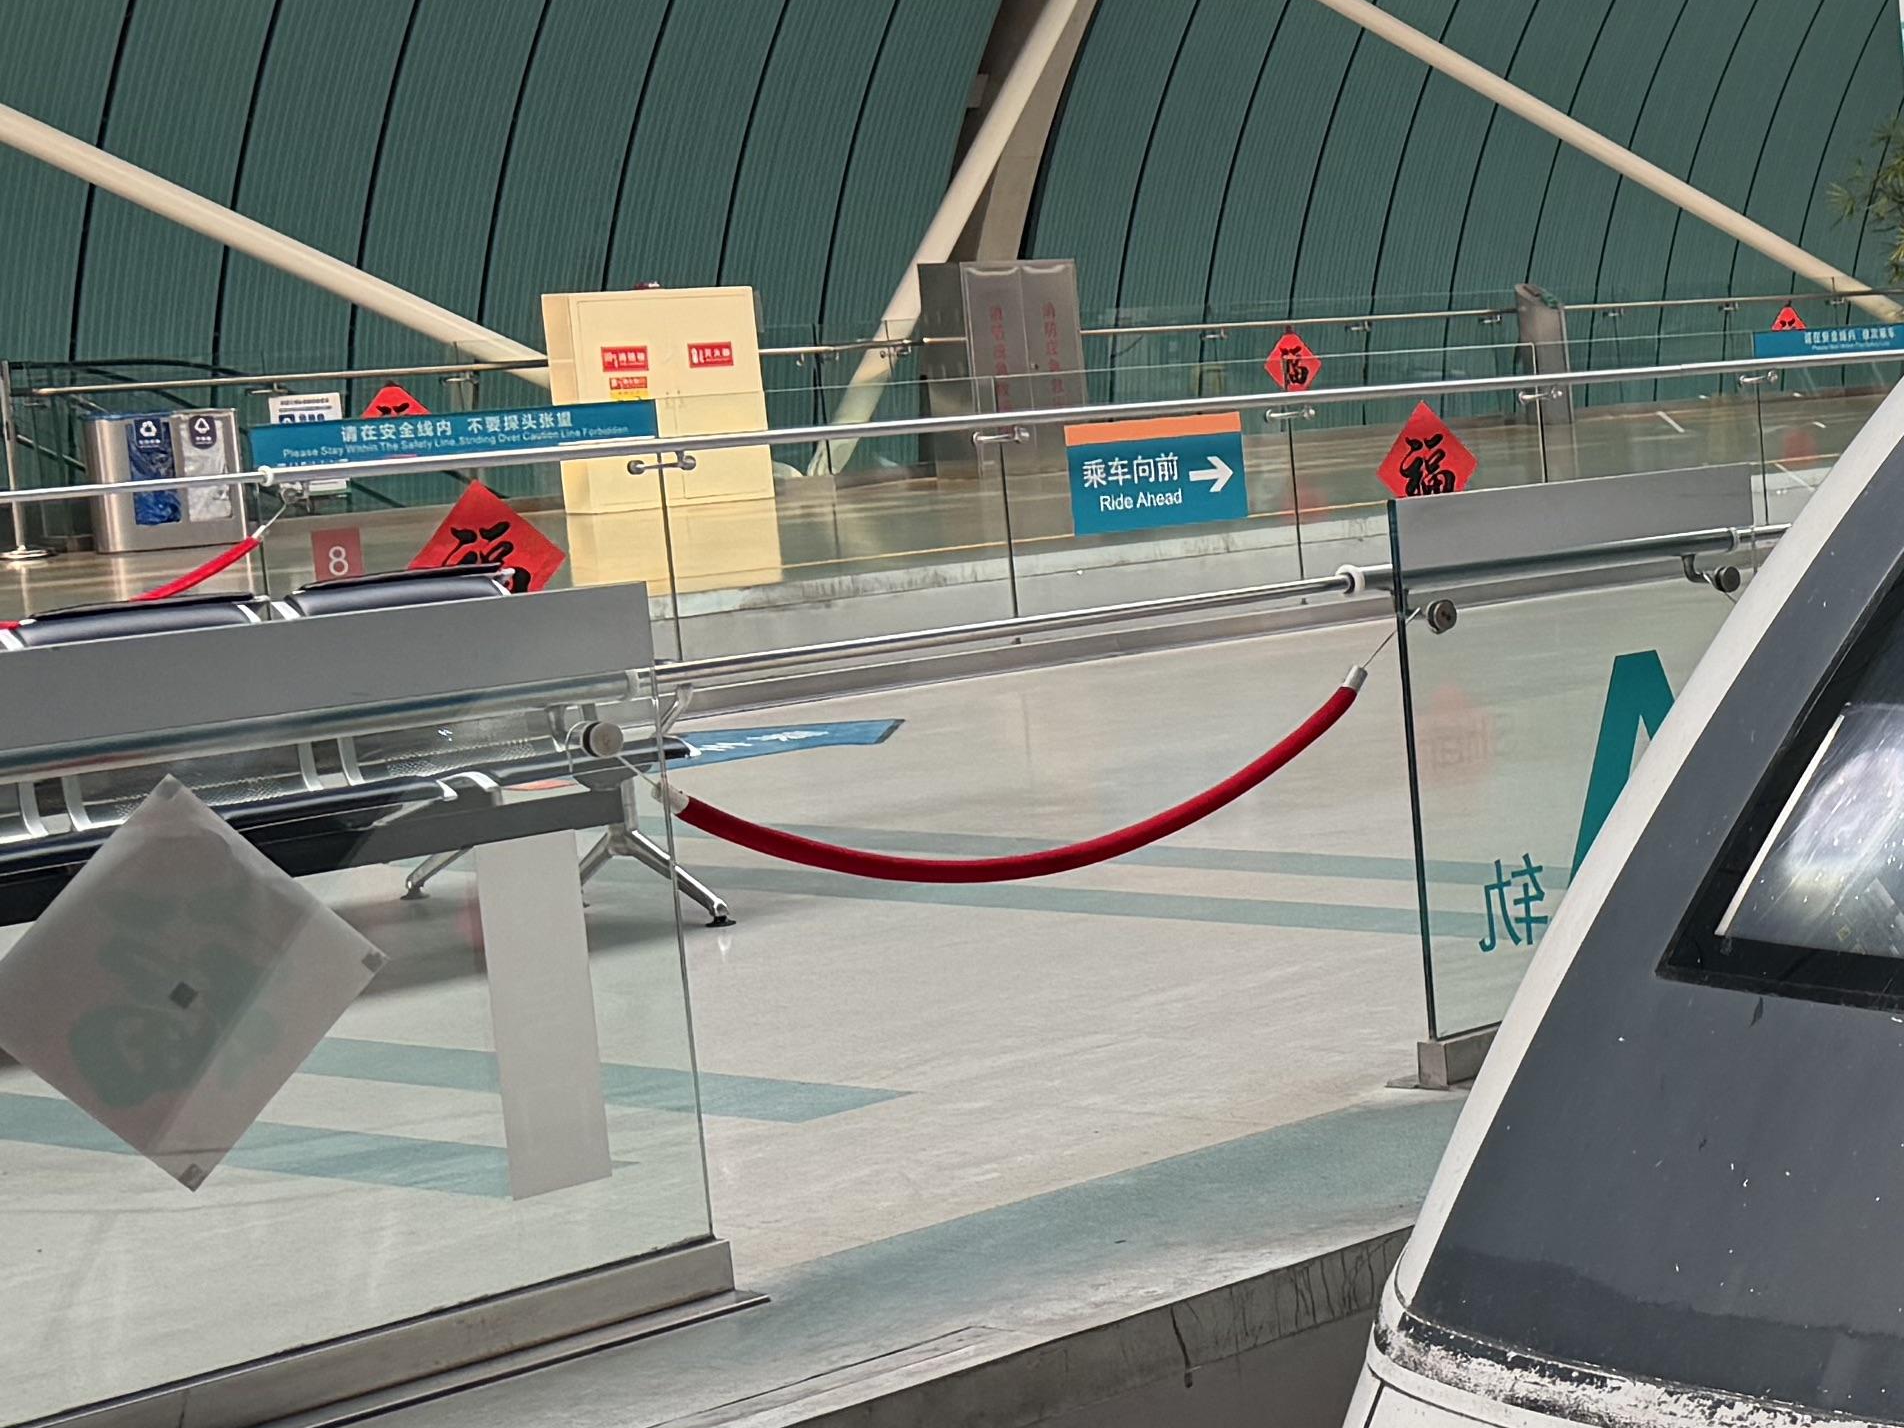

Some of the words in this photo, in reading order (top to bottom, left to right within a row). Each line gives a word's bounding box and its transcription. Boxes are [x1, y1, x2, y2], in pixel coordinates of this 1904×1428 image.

[340, 420, 452, 443] 请在安全线内
[283, 447, 319, 458] Please
[320, 445, 344, 457] Stay
[381, 441, 398, 452] The
[1082, 452, 1179, 489] 乘车向前
[1400, 434, 1455, 497] 福
[1099, 493, 1134, 512] Ride
[1136, 488, 1183, 509] Ahead
[328, 545, 349, 576] 8
